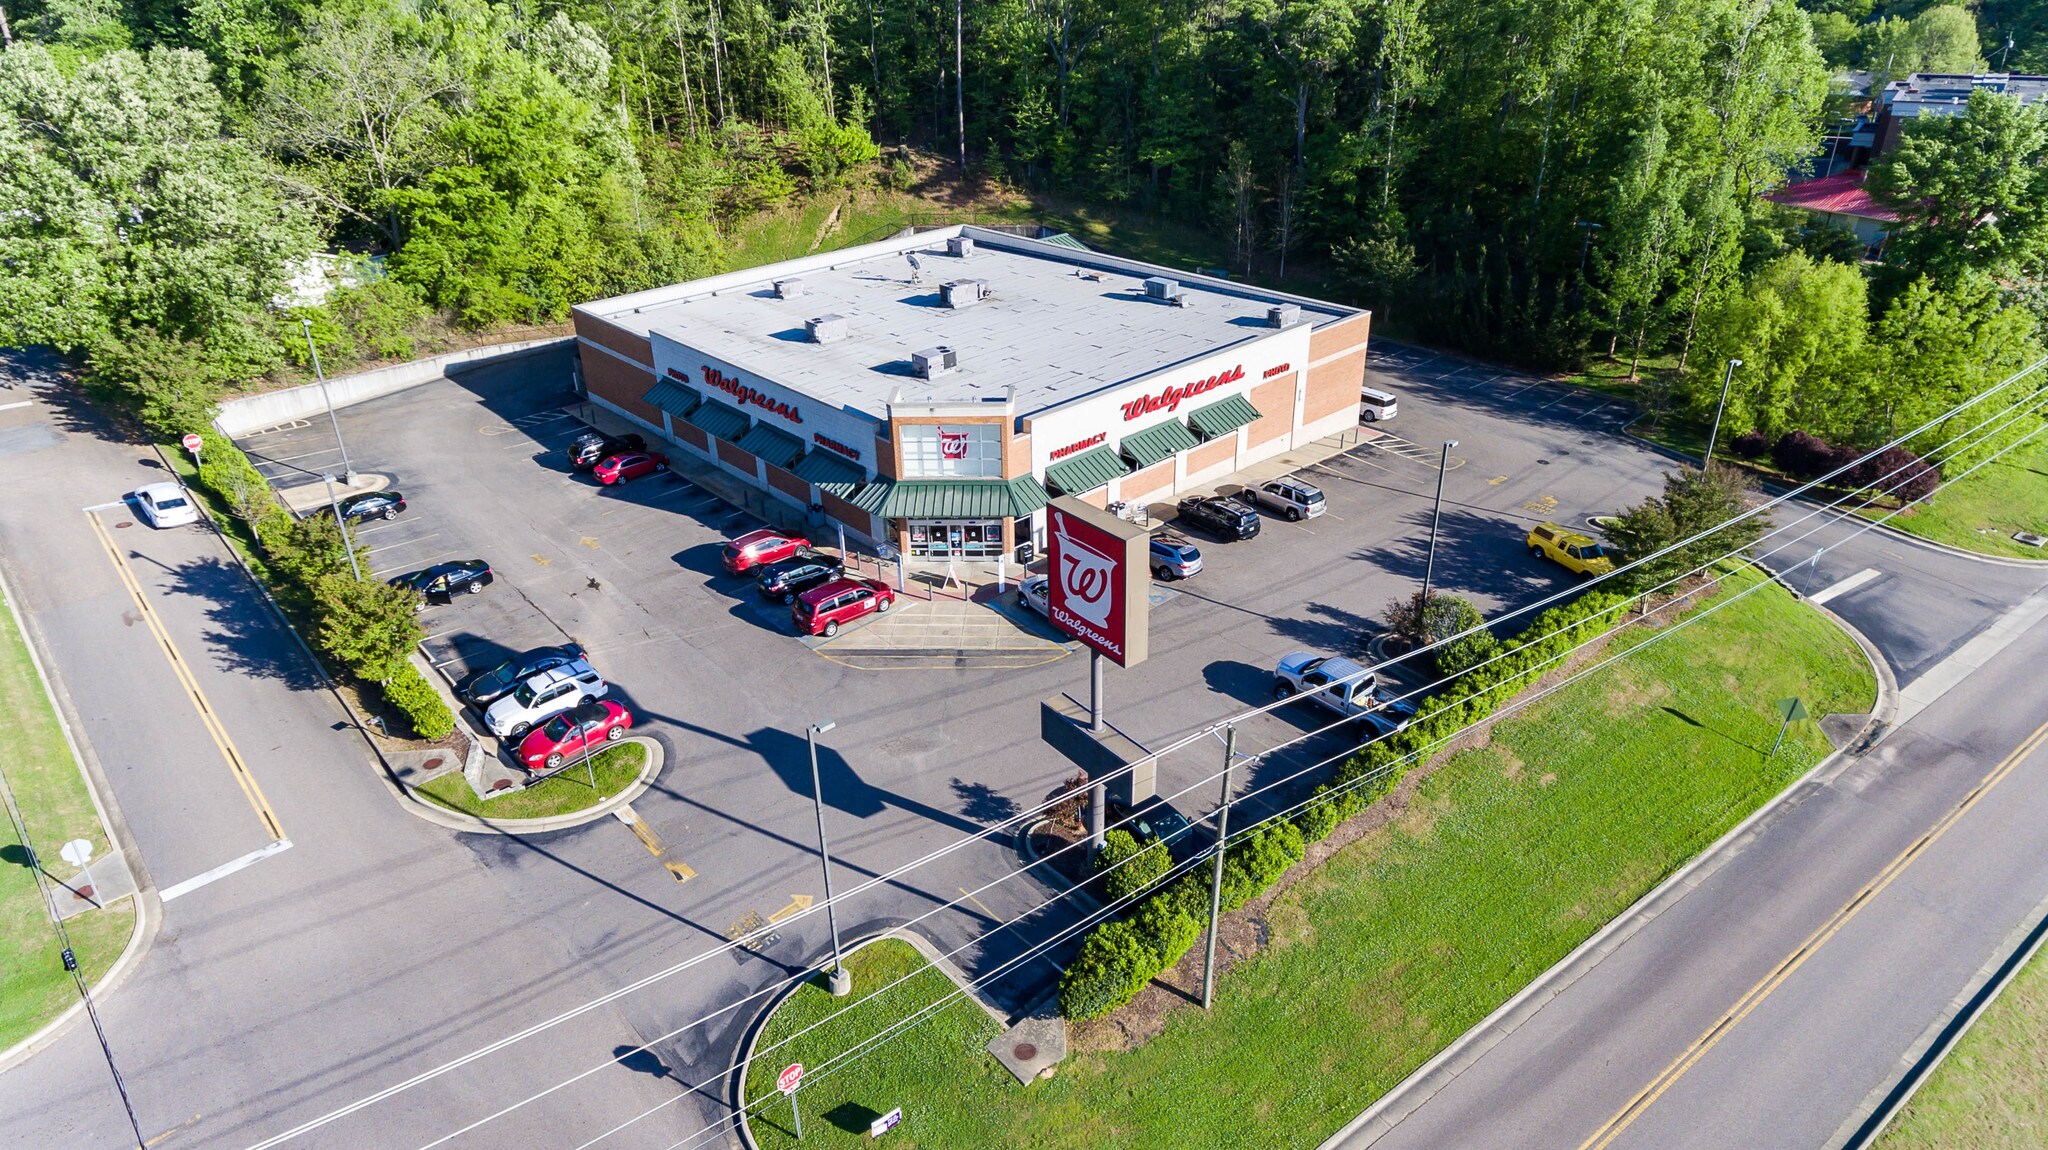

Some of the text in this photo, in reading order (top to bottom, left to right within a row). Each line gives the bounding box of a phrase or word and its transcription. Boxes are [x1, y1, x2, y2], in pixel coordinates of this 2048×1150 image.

[701, 365, 803, 423] Walgreens
[1120, 364, 1245, 421] Walgreens
[814, 433, 860, 460] PHARMACY
[1050, 432, 1106, 461] PHARMACY
[1052, 606, 1121, 656] Walgreens
[779, 1067, 800, 1087] STOP
